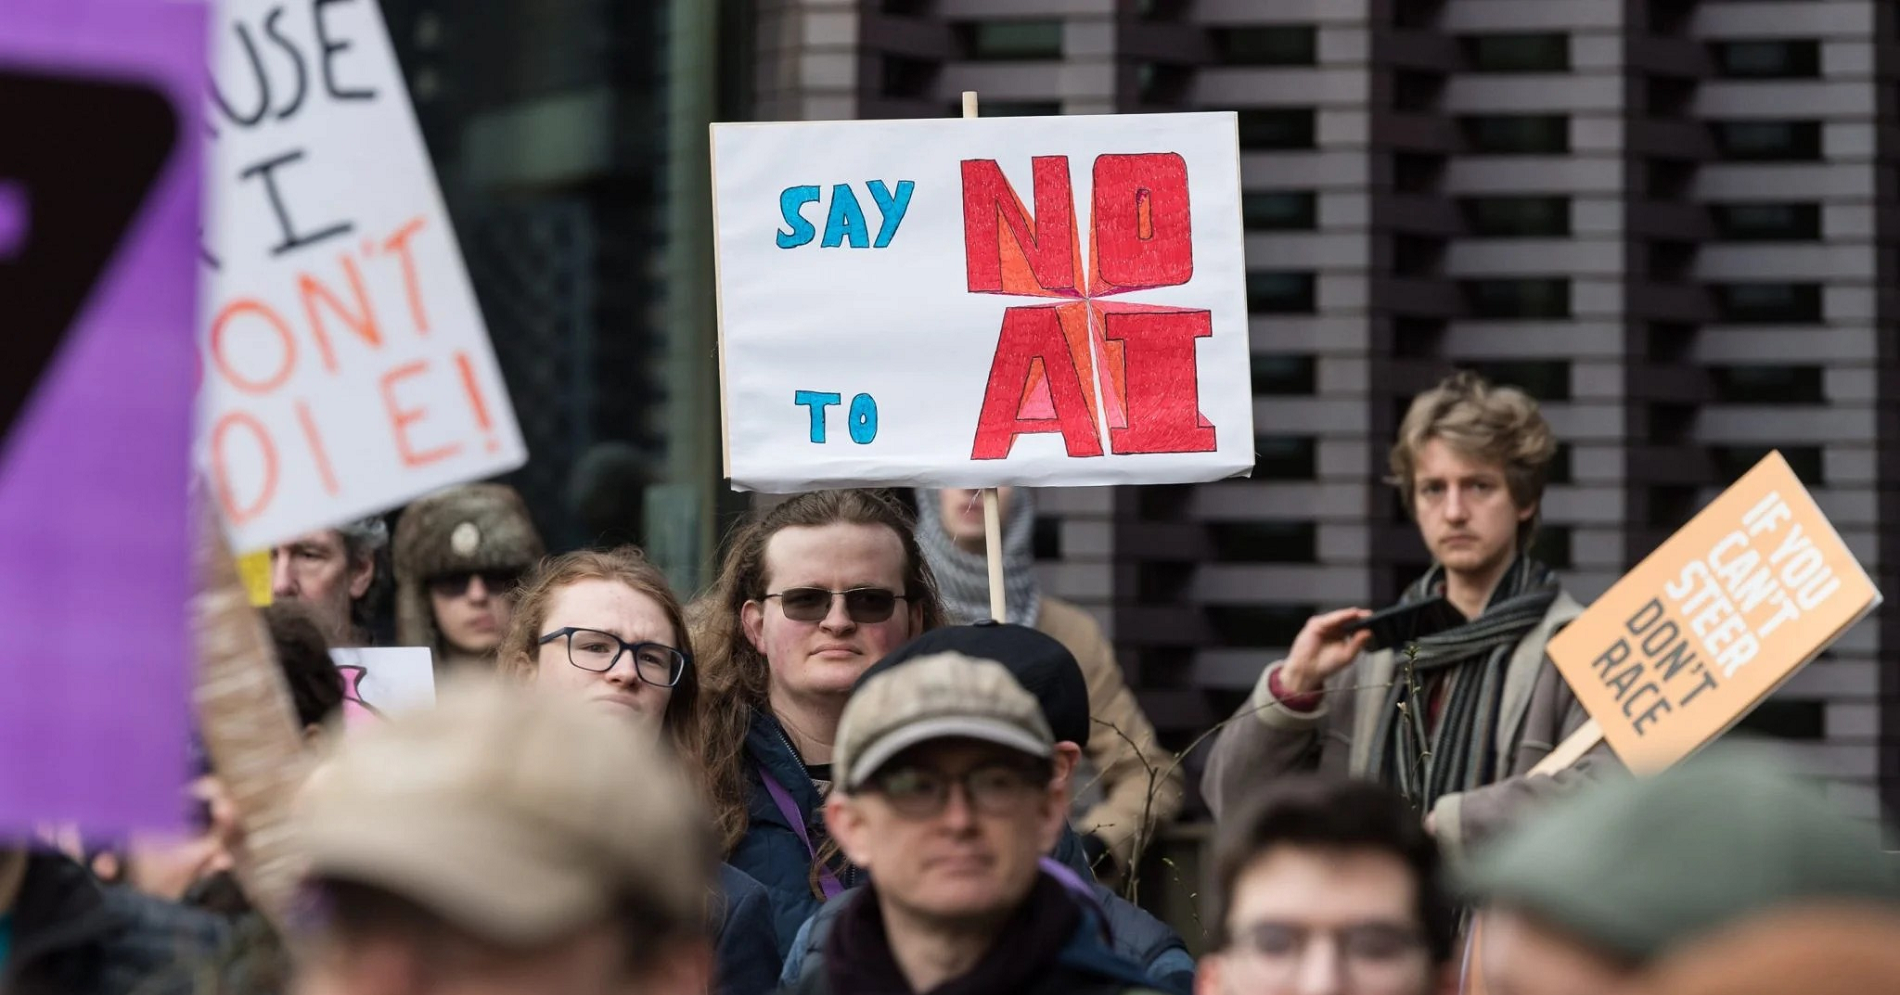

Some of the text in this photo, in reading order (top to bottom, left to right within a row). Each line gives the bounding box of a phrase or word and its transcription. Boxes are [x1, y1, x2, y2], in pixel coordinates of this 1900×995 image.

[202, 0, 379, 139] USE
[199, 147, 356, 269] I
[776, 151, 1194, 293] SAY NO
[196, 215, 430, 395] ON'T
[794, 305, 1218, 460] TO AI
[1708, 529, 1801, 640] CAN'T
[1742, 489, 1842, 612] IF YOU
[1625, 596, 1718, 708] DON'T
[1663, 558, 1760, 680] STEER
[1591, 638, 1673, 737] RACE
